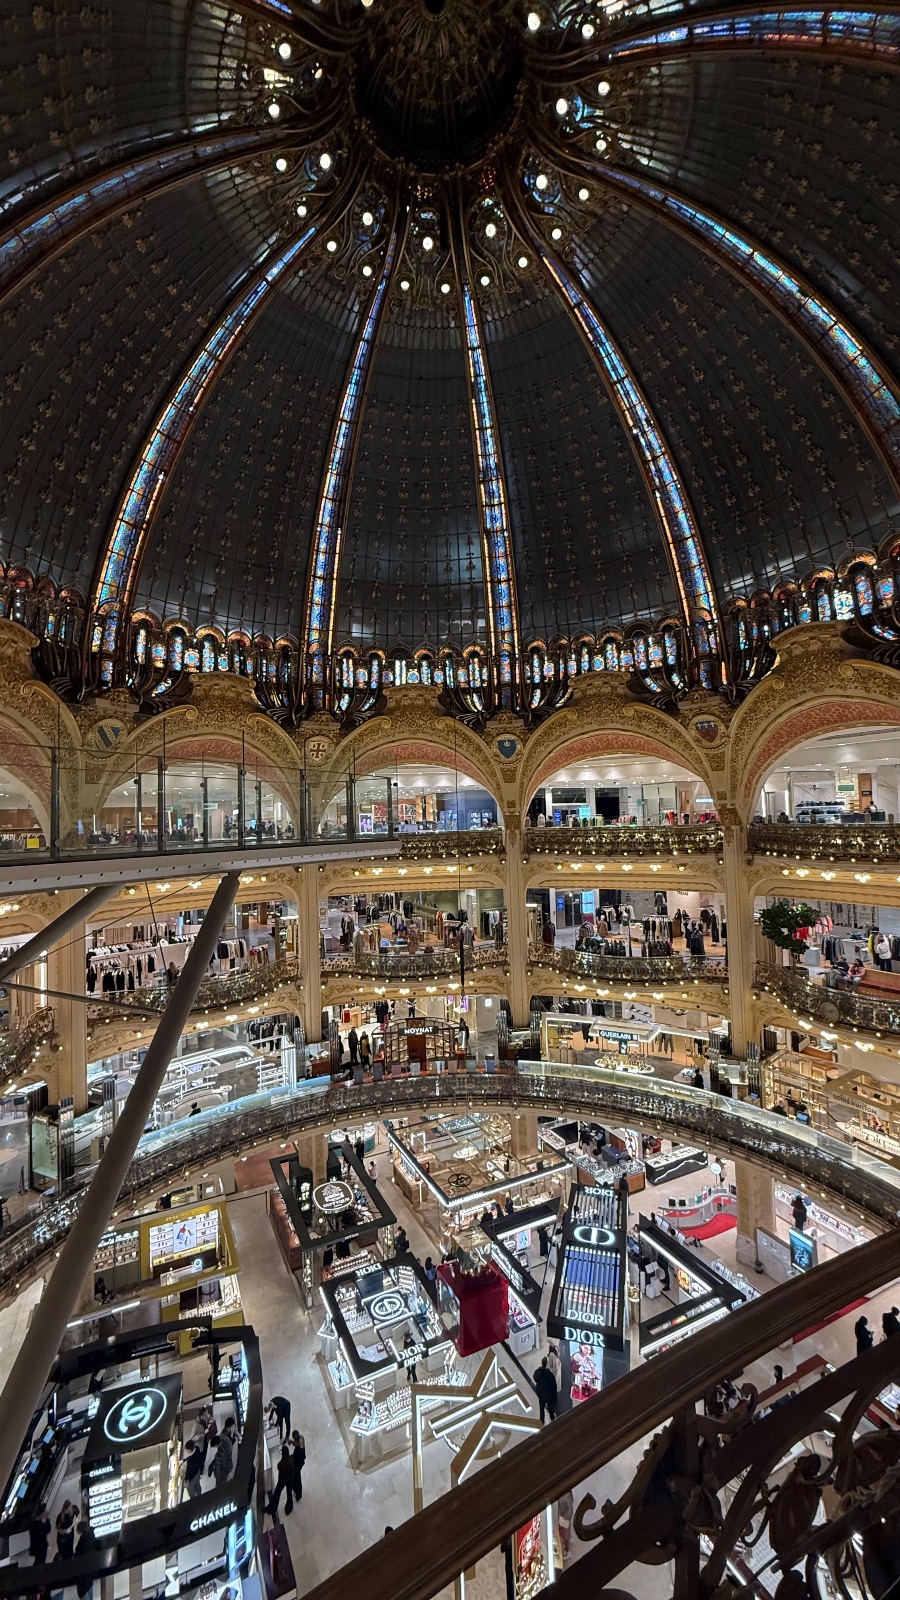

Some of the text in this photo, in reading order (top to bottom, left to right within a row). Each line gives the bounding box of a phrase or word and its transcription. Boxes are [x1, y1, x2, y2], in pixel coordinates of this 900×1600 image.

[600, 1030, 632, 1040] GUERLAIN
[833, 1093, 877, 1115] LOUIS VUITTON
[584, 1186, 614, 1197] DIOR
[355, 1262, 382, 1277] DIOR
[566, 1309, 606, 1326] DIOR
[564, 1326, 606, 1348] DIOR
[397, 1342, 427, 1362] DIOR
[403, 1353, 423, 1368] DIOR
[89, 1465, 114, 1478] CHANEL
[189, 1501, 238, 1532] CHANEL
